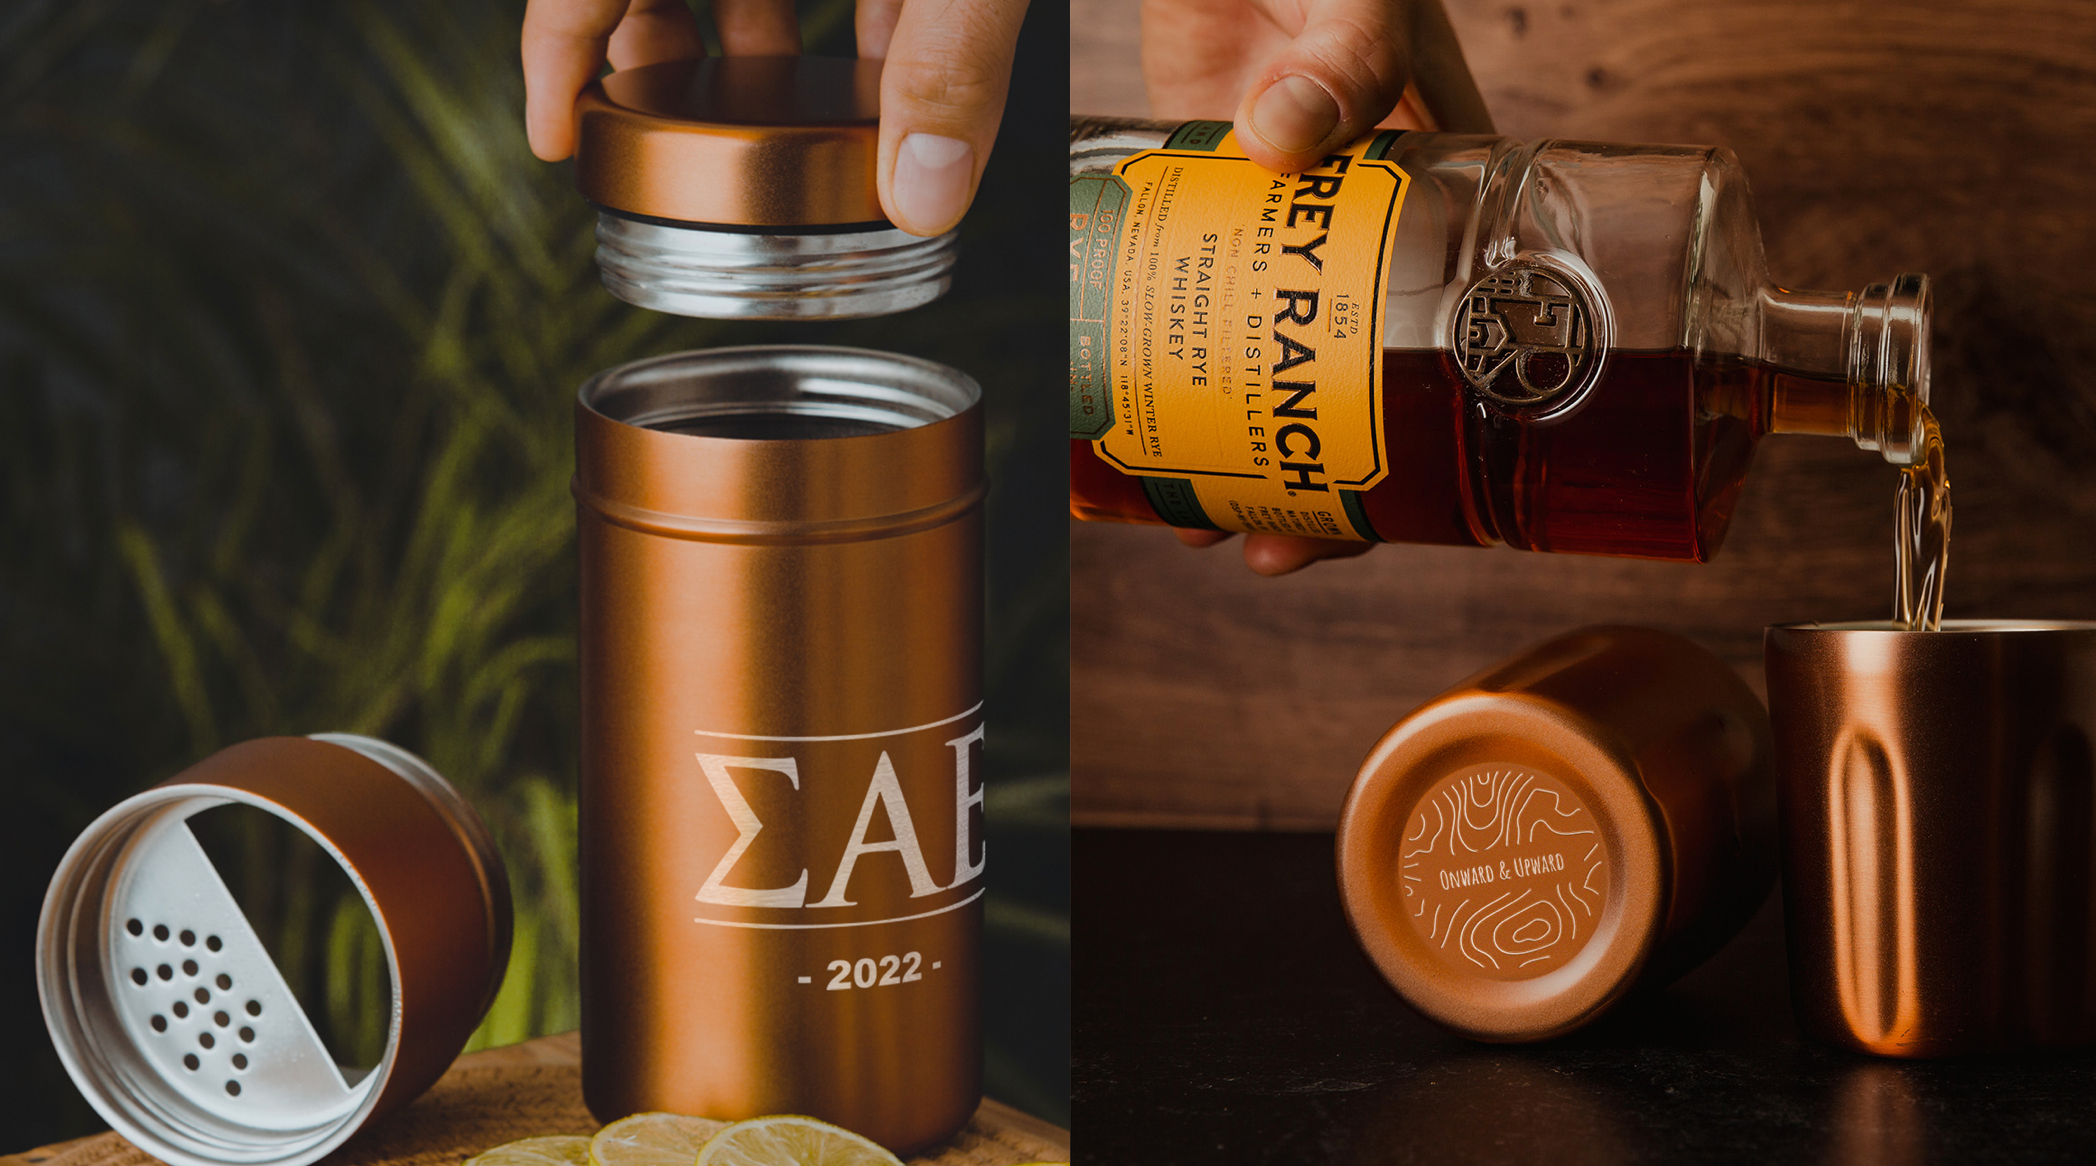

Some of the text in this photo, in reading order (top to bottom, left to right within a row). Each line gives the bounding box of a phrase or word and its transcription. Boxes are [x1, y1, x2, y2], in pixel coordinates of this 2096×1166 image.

[1089, 209, 1115, 290] 100 PROOF
[1279, 154, 1354, 276] FREY
[1142, 167, 1183, 458] DISTILLED from 100% SLOW-GROWN WINTER RYE
[1169, 256, 1191, 360] WHISKEY
[1192, 233, 1218, 386] STRAIGHT RYE
[1223, 265, 1237, 311] CHILL
[1334, 294, 1349, 340] 1854
[1350, 302, 1359, 335] ESTD
[1080, 335, 1094, 416] BOTTLED
[1245, 315, 1269, 466] DISTILLERS
[1500, 861, 1511, 881] &
[826, 951, 922, 991] 2022
